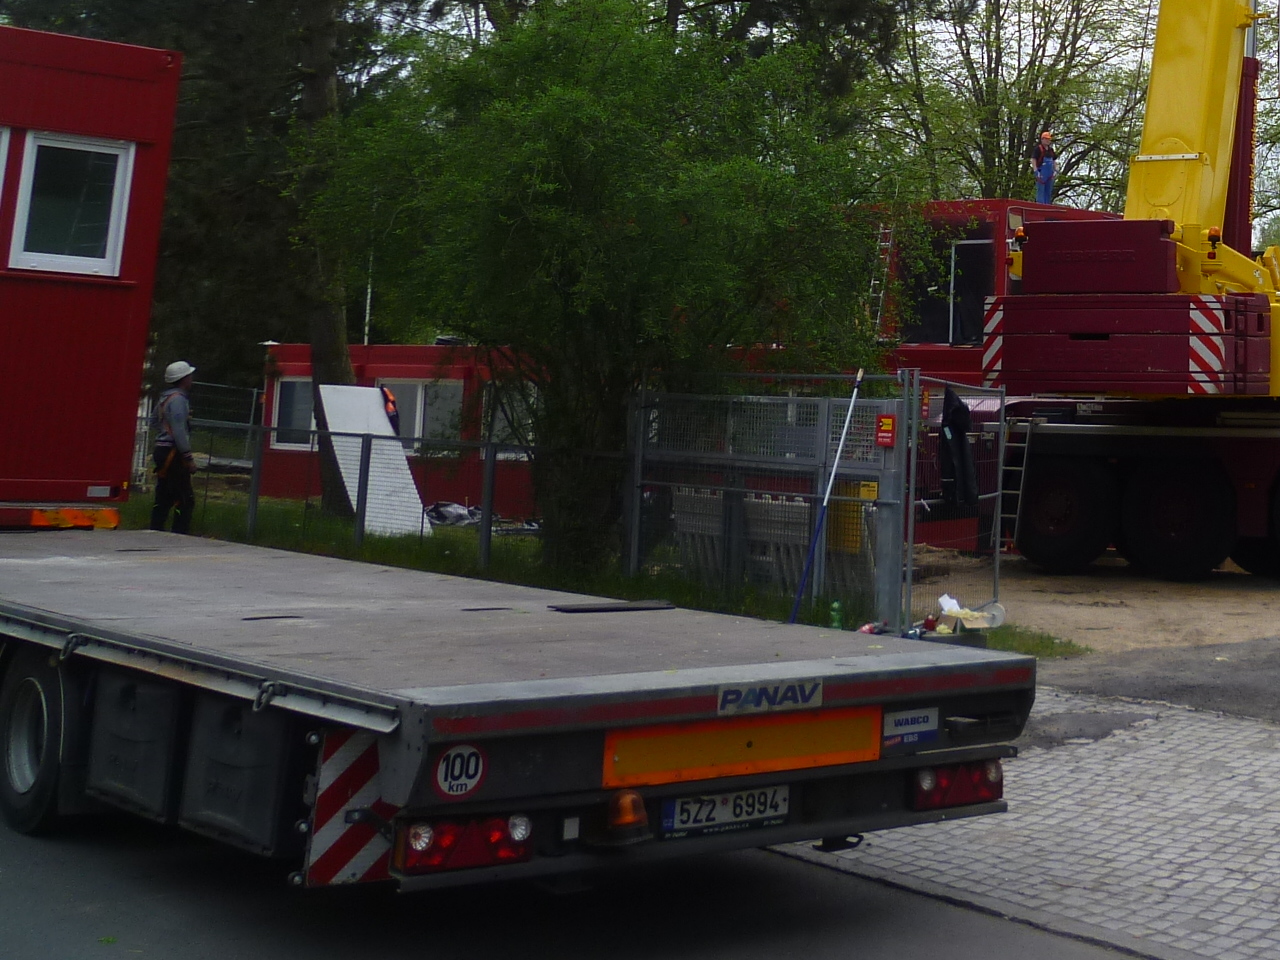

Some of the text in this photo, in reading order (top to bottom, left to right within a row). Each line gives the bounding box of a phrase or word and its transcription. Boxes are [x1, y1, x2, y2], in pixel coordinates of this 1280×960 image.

[720, 683, 821, 711] PANAV
[894, 715, 929, 727] WABCO
[904, 734, 918, 742] EBS
[442, 751, 480, 782] 100
[448, 781, 468, 792] km
[733, 789, 779, 818] 6994
